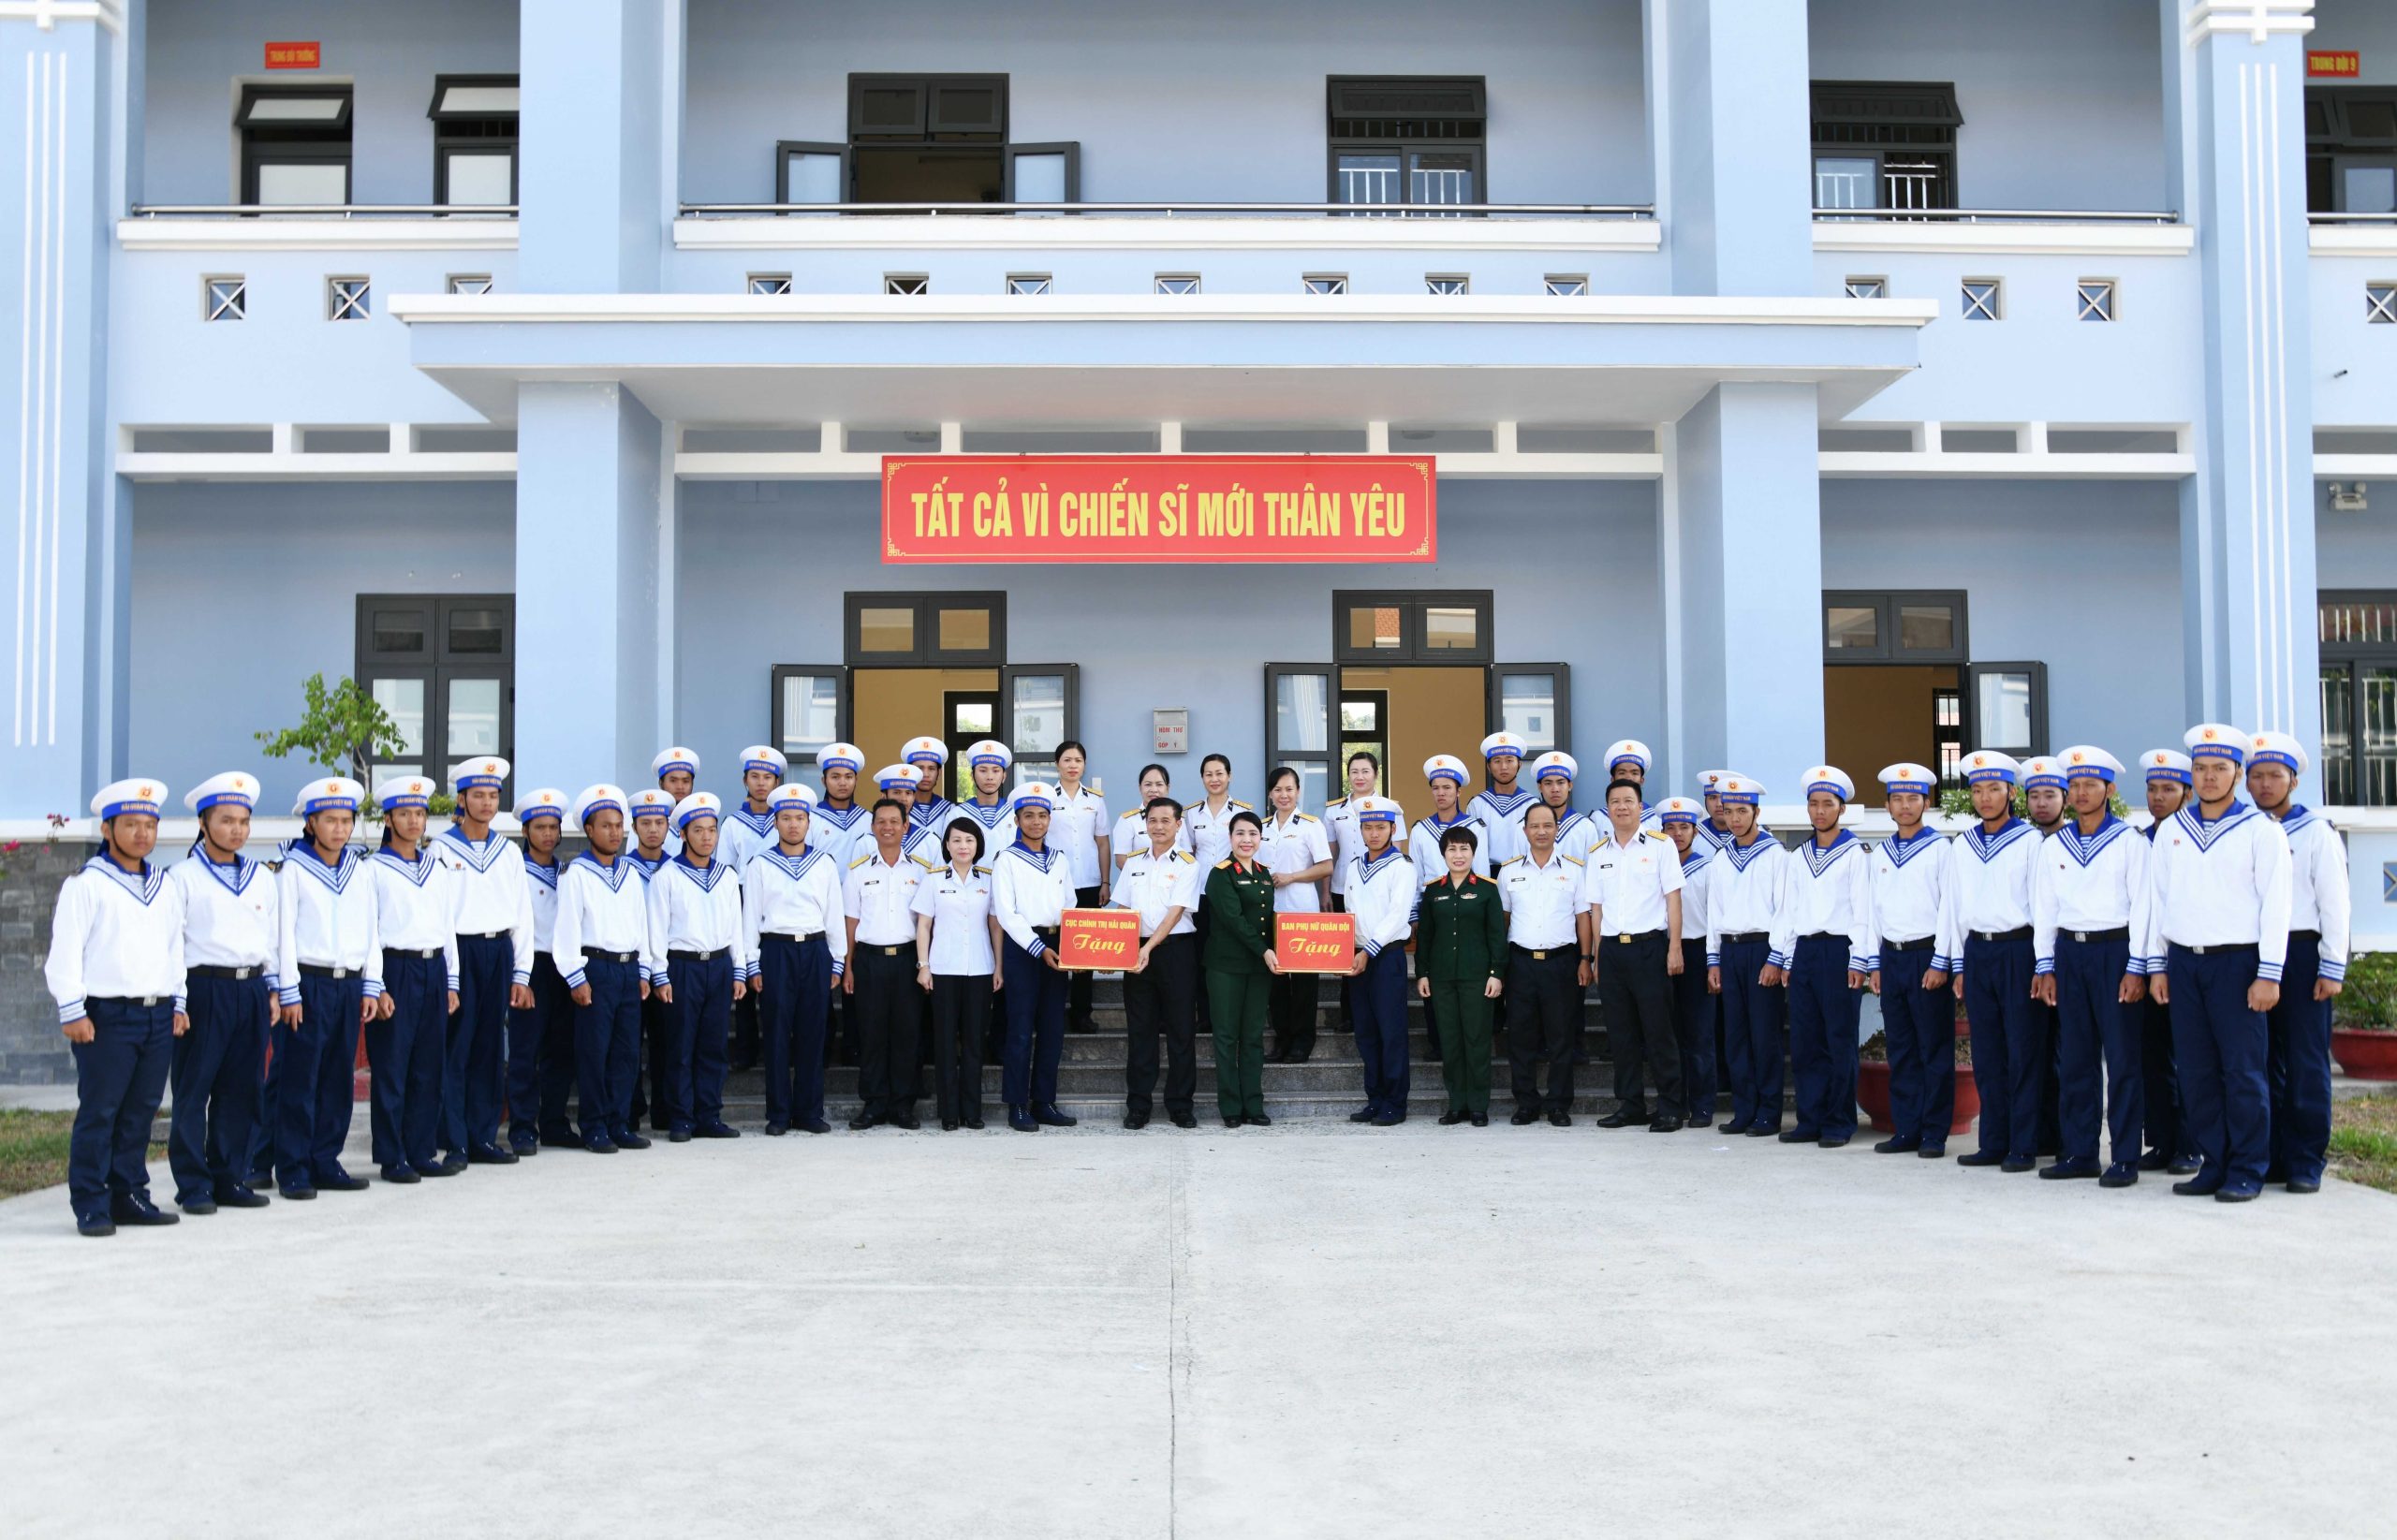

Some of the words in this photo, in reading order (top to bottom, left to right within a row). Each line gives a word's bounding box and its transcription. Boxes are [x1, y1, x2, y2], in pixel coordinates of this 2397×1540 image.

[2310, 56, 2334, 71] TRUNG
[912, 477, 963, 537] TẤT
[974, 477, 1013, 537] CẢ
[1022, 482, 1049, 537] VÌ
[1060, 477, 1149, 537] CHIẾN
[1159, 483, 1189, 537] SĨ
[1198, 482, 1255, 537] MỚI
[1264, 482, 1341, 537] THÂN
[1350, 482, 1405, 537] YÊU
[1066, 919, 1078, 929] CỤC
[1079, 918, 1096, 929] CHÍNH
[1120, 920, 1137, 930] QUÂN
[1282, 922, 1295, 931] BAN
[1296, 922, 1309, 931] PHỤ
[1310, 921, 1320, 931] NỮ
[1321, 921, 1338, 931] QUÂN
[1339, 921, 1350, 932] ĐỘI
[1073, 933, 1125, 955] Tặng
[1289, 937, 1342, 958] Tặng
